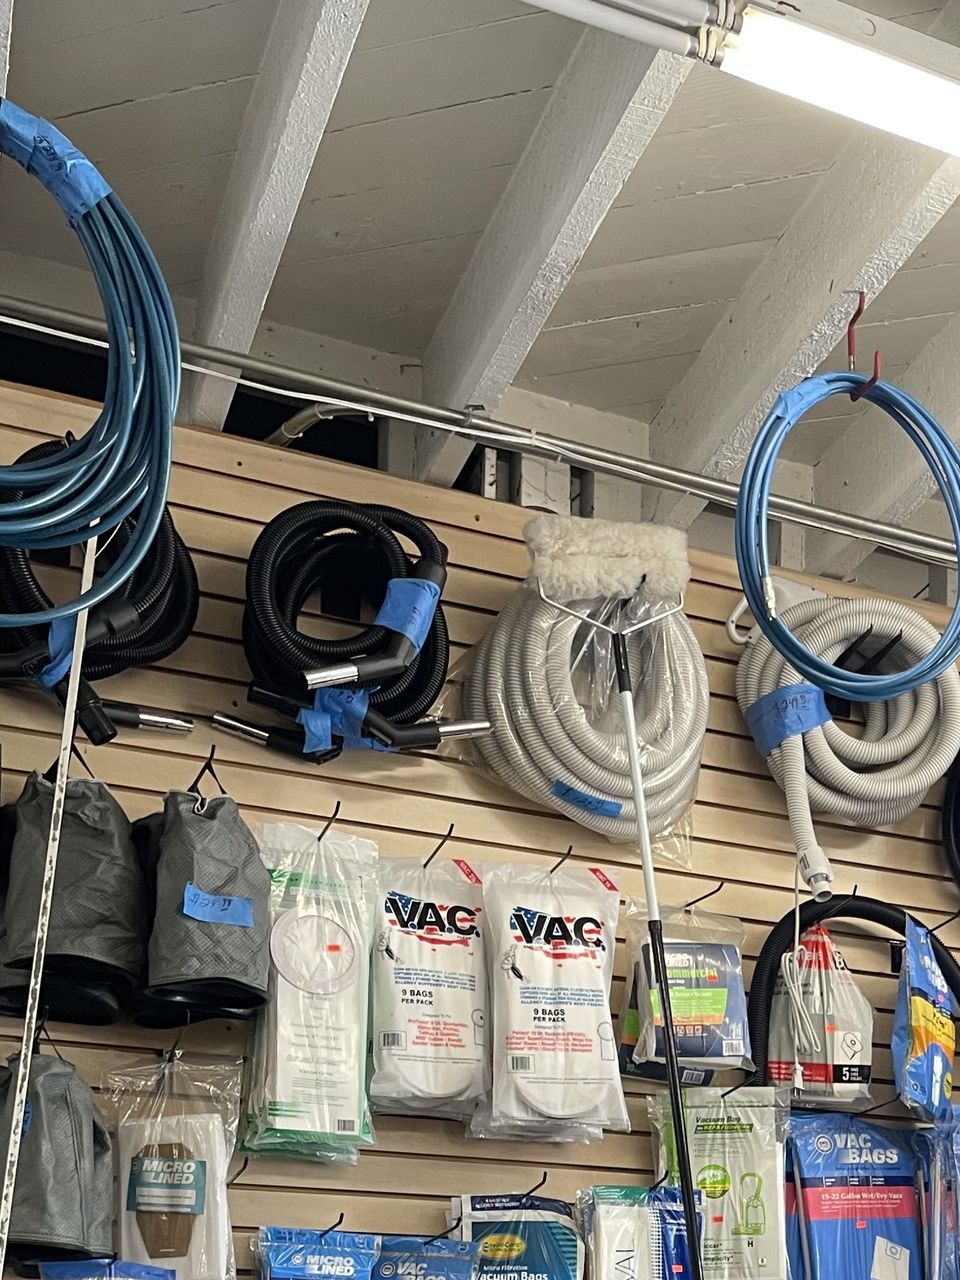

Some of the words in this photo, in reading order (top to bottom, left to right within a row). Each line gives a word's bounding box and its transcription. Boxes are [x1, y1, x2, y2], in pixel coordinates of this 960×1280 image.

[402, 989, 408, 998] 9
[410, 989, 433, 999] BAGS
[533, 1008, 540, 1017] 9
[542, 1008, 566, 1017] BAGS
[834, 1133, 872, 1149] VAC
[849, 1148, 899, 1165] BAGS
[142, 1159, 197, 1174] MICRO
[150, 1171, 195, 1186] LINED
[306, 1255, 355, 1267] MICRO
[313, 1265, 355, 1277] LINED
[397, 1262, 428, 1276] VAC
